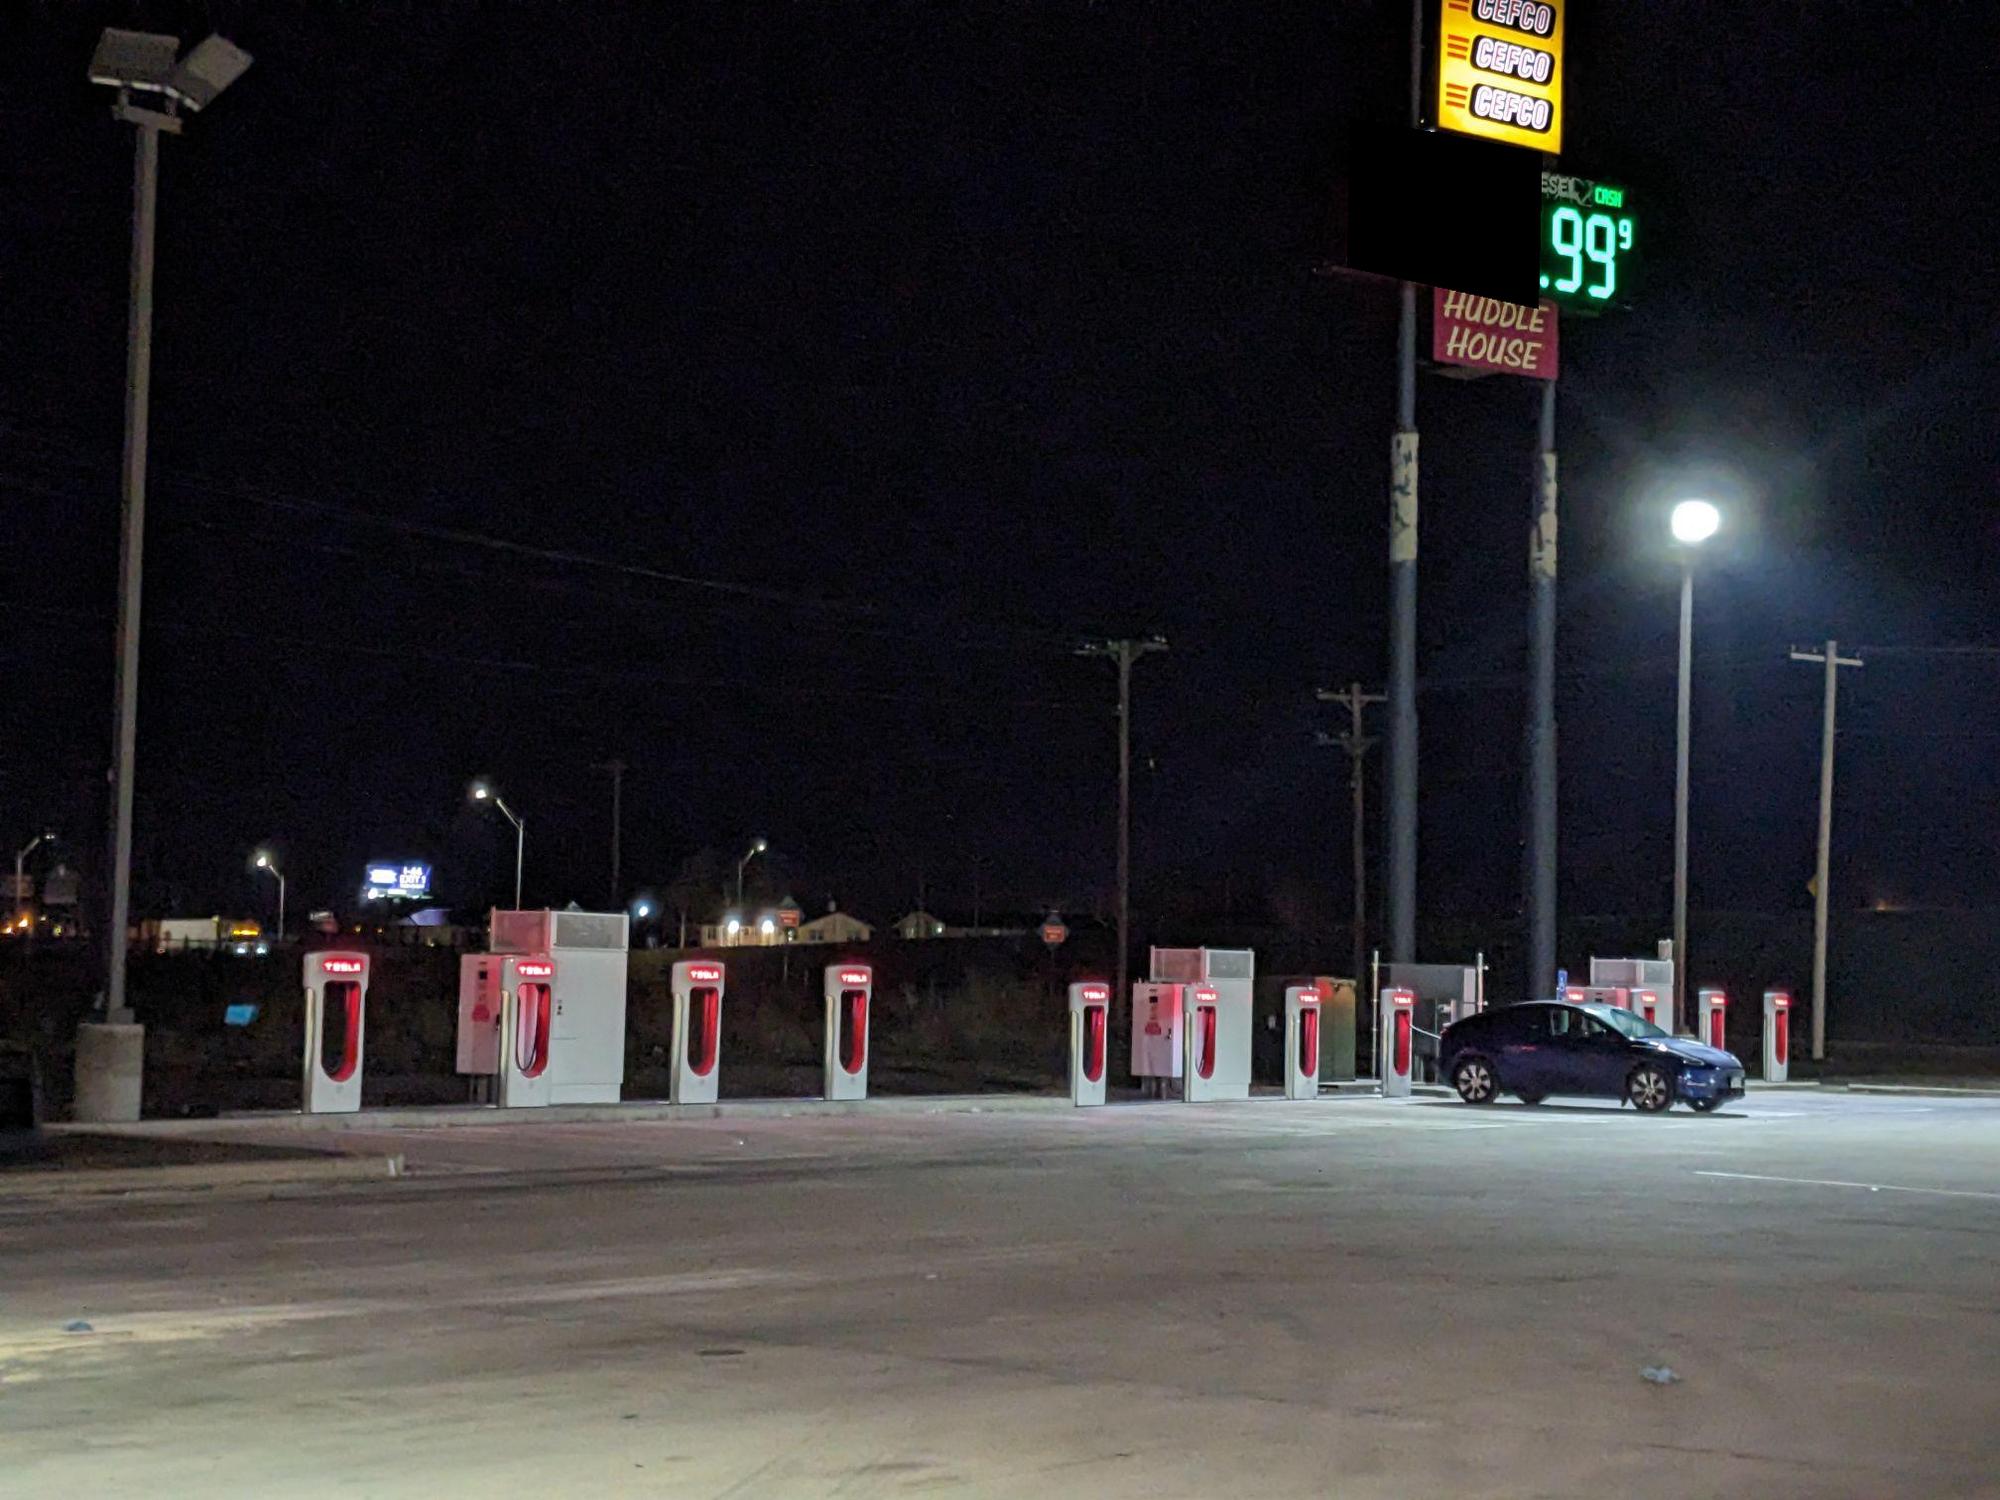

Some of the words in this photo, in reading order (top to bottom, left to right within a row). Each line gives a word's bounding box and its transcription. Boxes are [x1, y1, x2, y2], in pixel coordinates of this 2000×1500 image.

[1477, 0, 1551, 35] CEFCO
[1475, 37, 1550, 82] CEFCO
[1474, 85, 1549, 130] CEFCO
[1594, 187, 1623, 208] CASH
[1443, 289, 1550, 334] HUDDLE
[1446, 325, 1543, 370] HOUSE
